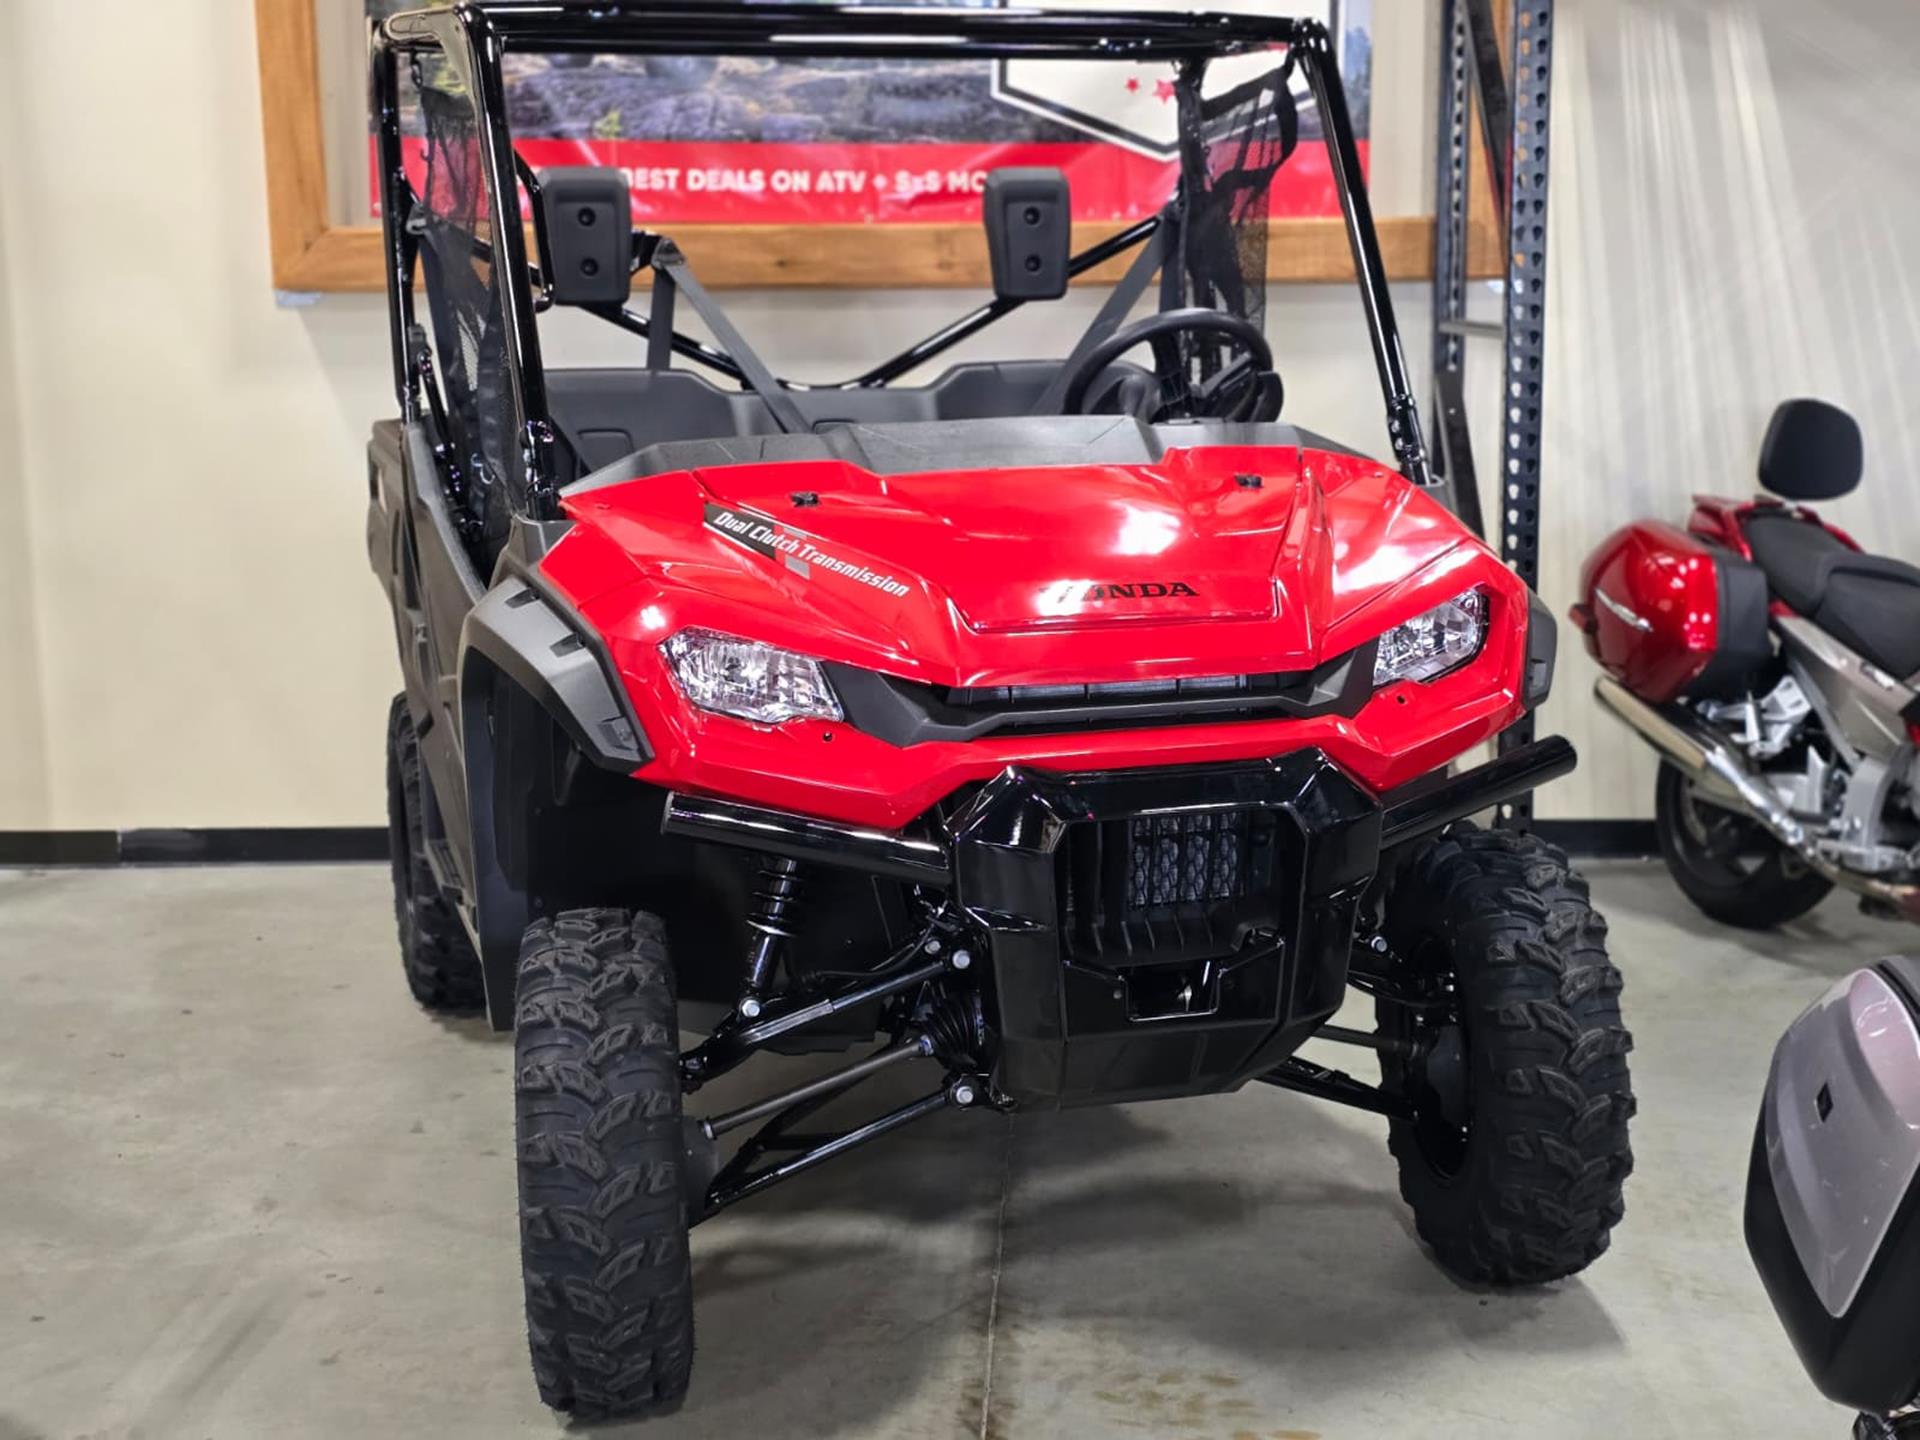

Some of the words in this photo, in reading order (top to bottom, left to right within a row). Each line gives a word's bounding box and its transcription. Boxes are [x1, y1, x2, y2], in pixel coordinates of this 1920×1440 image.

[686, 168, 766, 192] DEALS
[770, 169, 811, 192] ON
[816, 170, 867, 193] ATV
[713, 511, 753, 534] Dual
[748, 525, 800, 554] Clutch
[797, 543, 911, 598] Transmission
